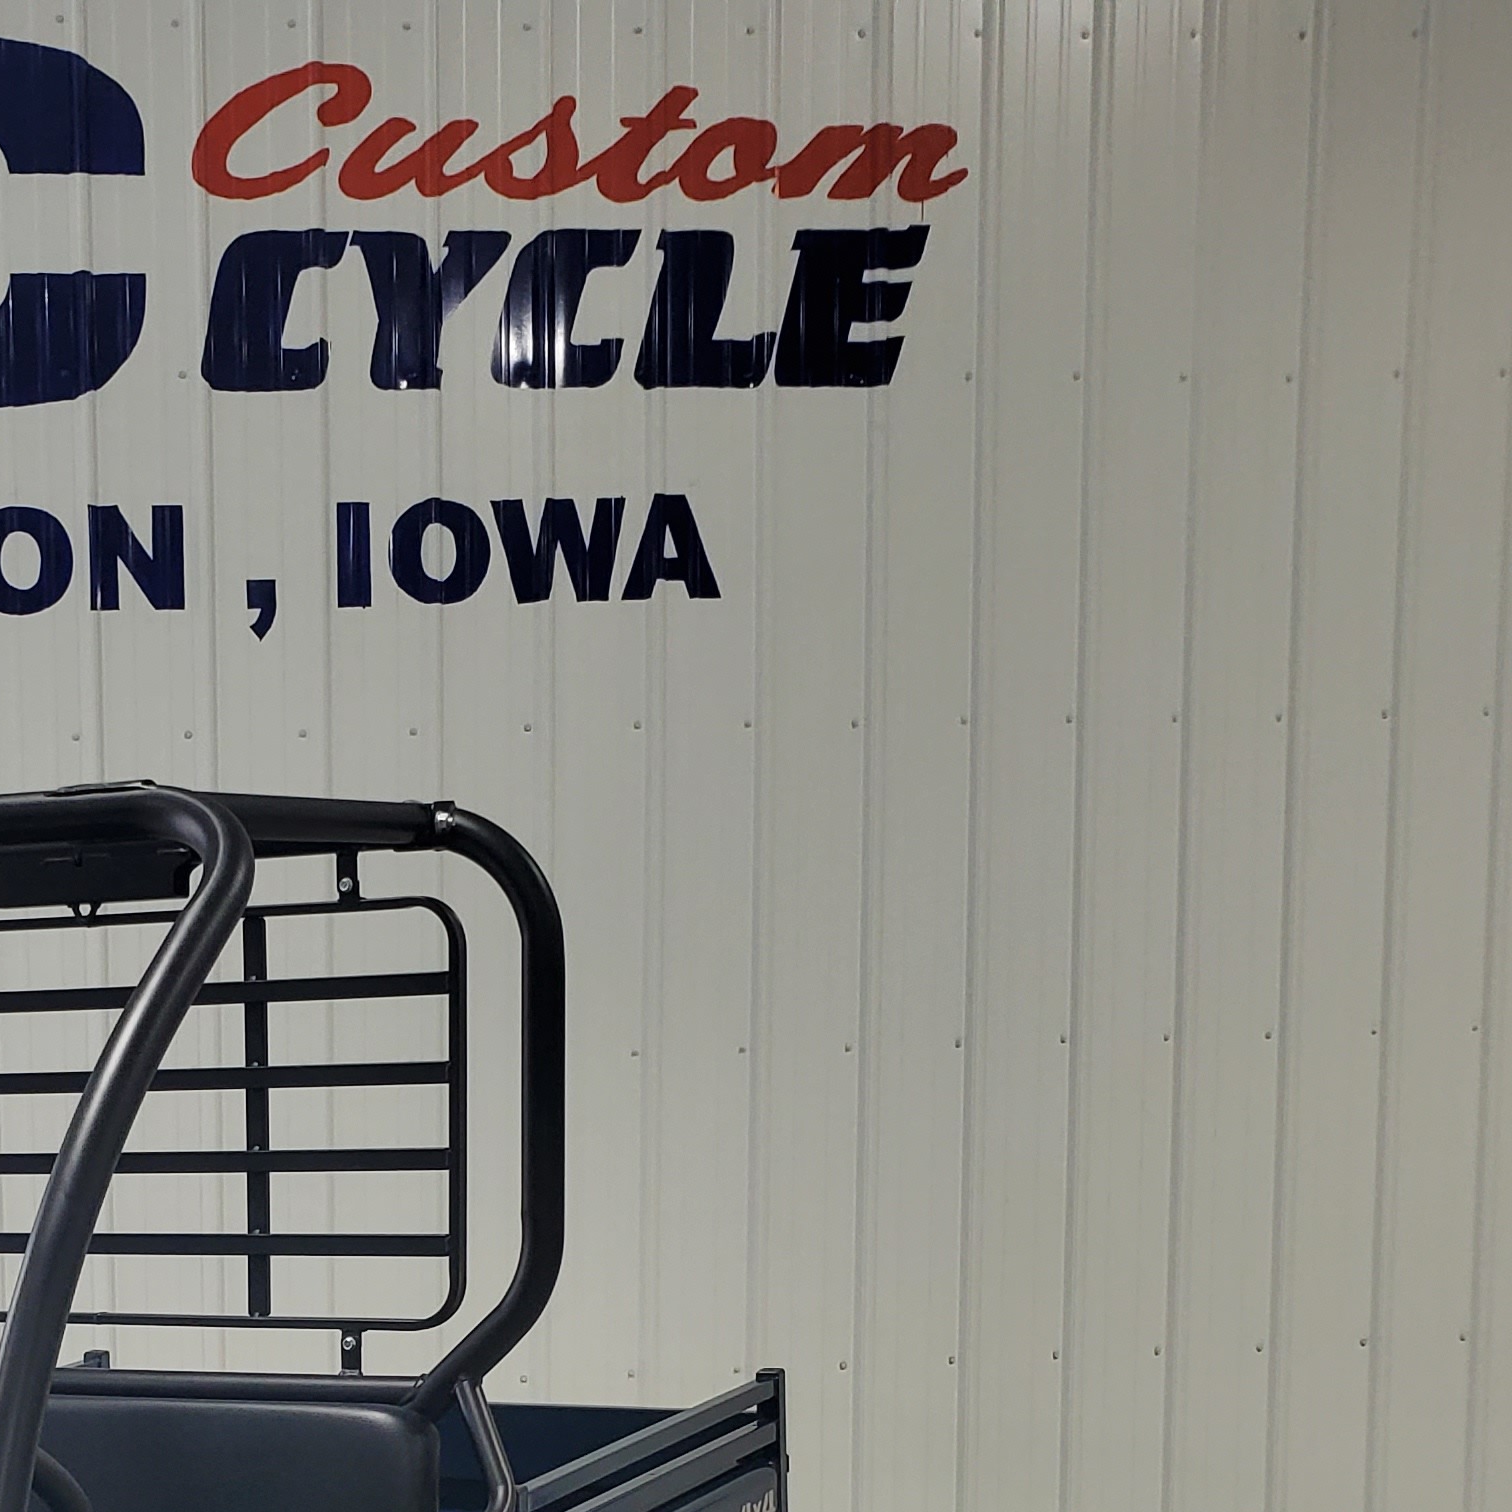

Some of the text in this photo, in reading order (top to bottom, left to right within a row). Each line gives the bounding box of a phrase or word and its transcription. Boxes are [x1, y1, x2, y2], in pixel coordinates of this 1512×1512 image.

[192, 60, 968, 203] Custom
[201, 225, 931, 391] CYCLE
[336, 493, 721, 608] IOWA
